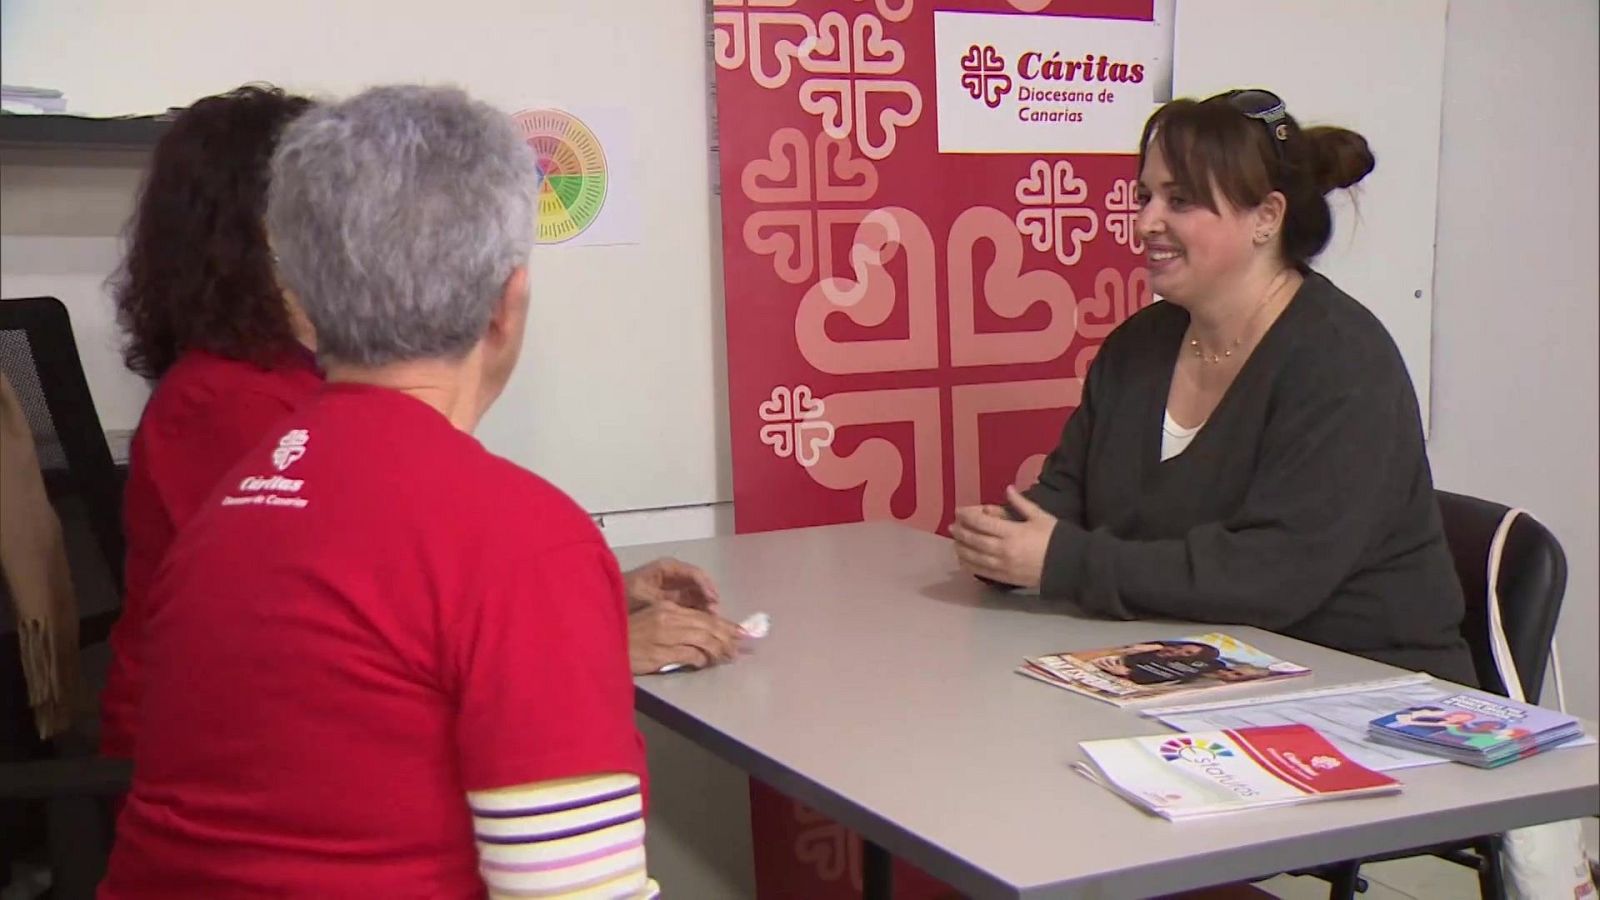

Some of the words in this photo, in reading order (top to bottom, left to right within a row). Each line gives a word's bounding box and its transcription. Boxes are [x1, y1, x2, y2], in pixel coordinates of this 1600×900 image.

[1017, 51, 1145, 83] Cáritas
[1018, 86, 1094, 103] Diocesana
[1098, 88, 1115, 103] de
[1018, 107, 1083, 122] Canarias
